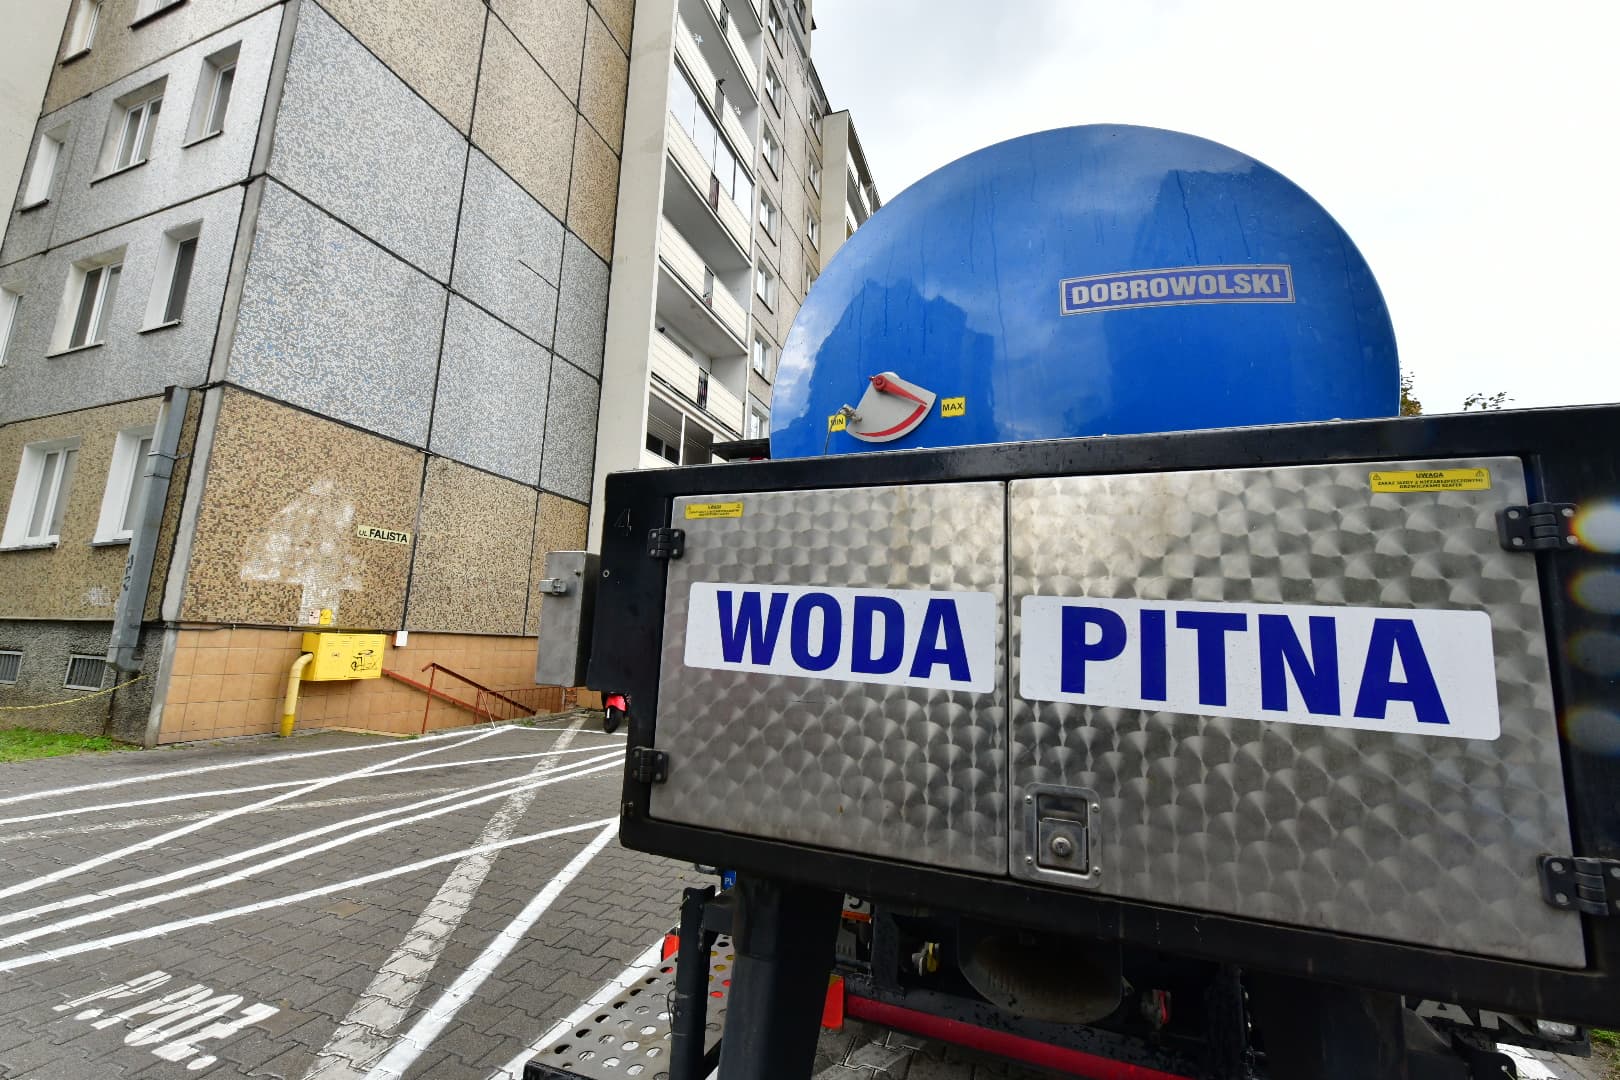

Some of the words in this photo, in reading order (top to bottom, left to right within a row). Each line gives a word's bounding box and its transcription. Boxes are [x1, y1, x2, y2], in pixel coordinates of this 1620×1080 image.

[1072, 274, 1281, 305] DOBROWOLSKI
[942, 402, 963, 412] MAX
[830, 417, 844, 426] MIN
[369, 528, 408, 543] FALISTA
[716, 590, 972, 682] WODA
[1060, 605, 1450, 725] PITNA
[724, 877, 734, 886] PL
